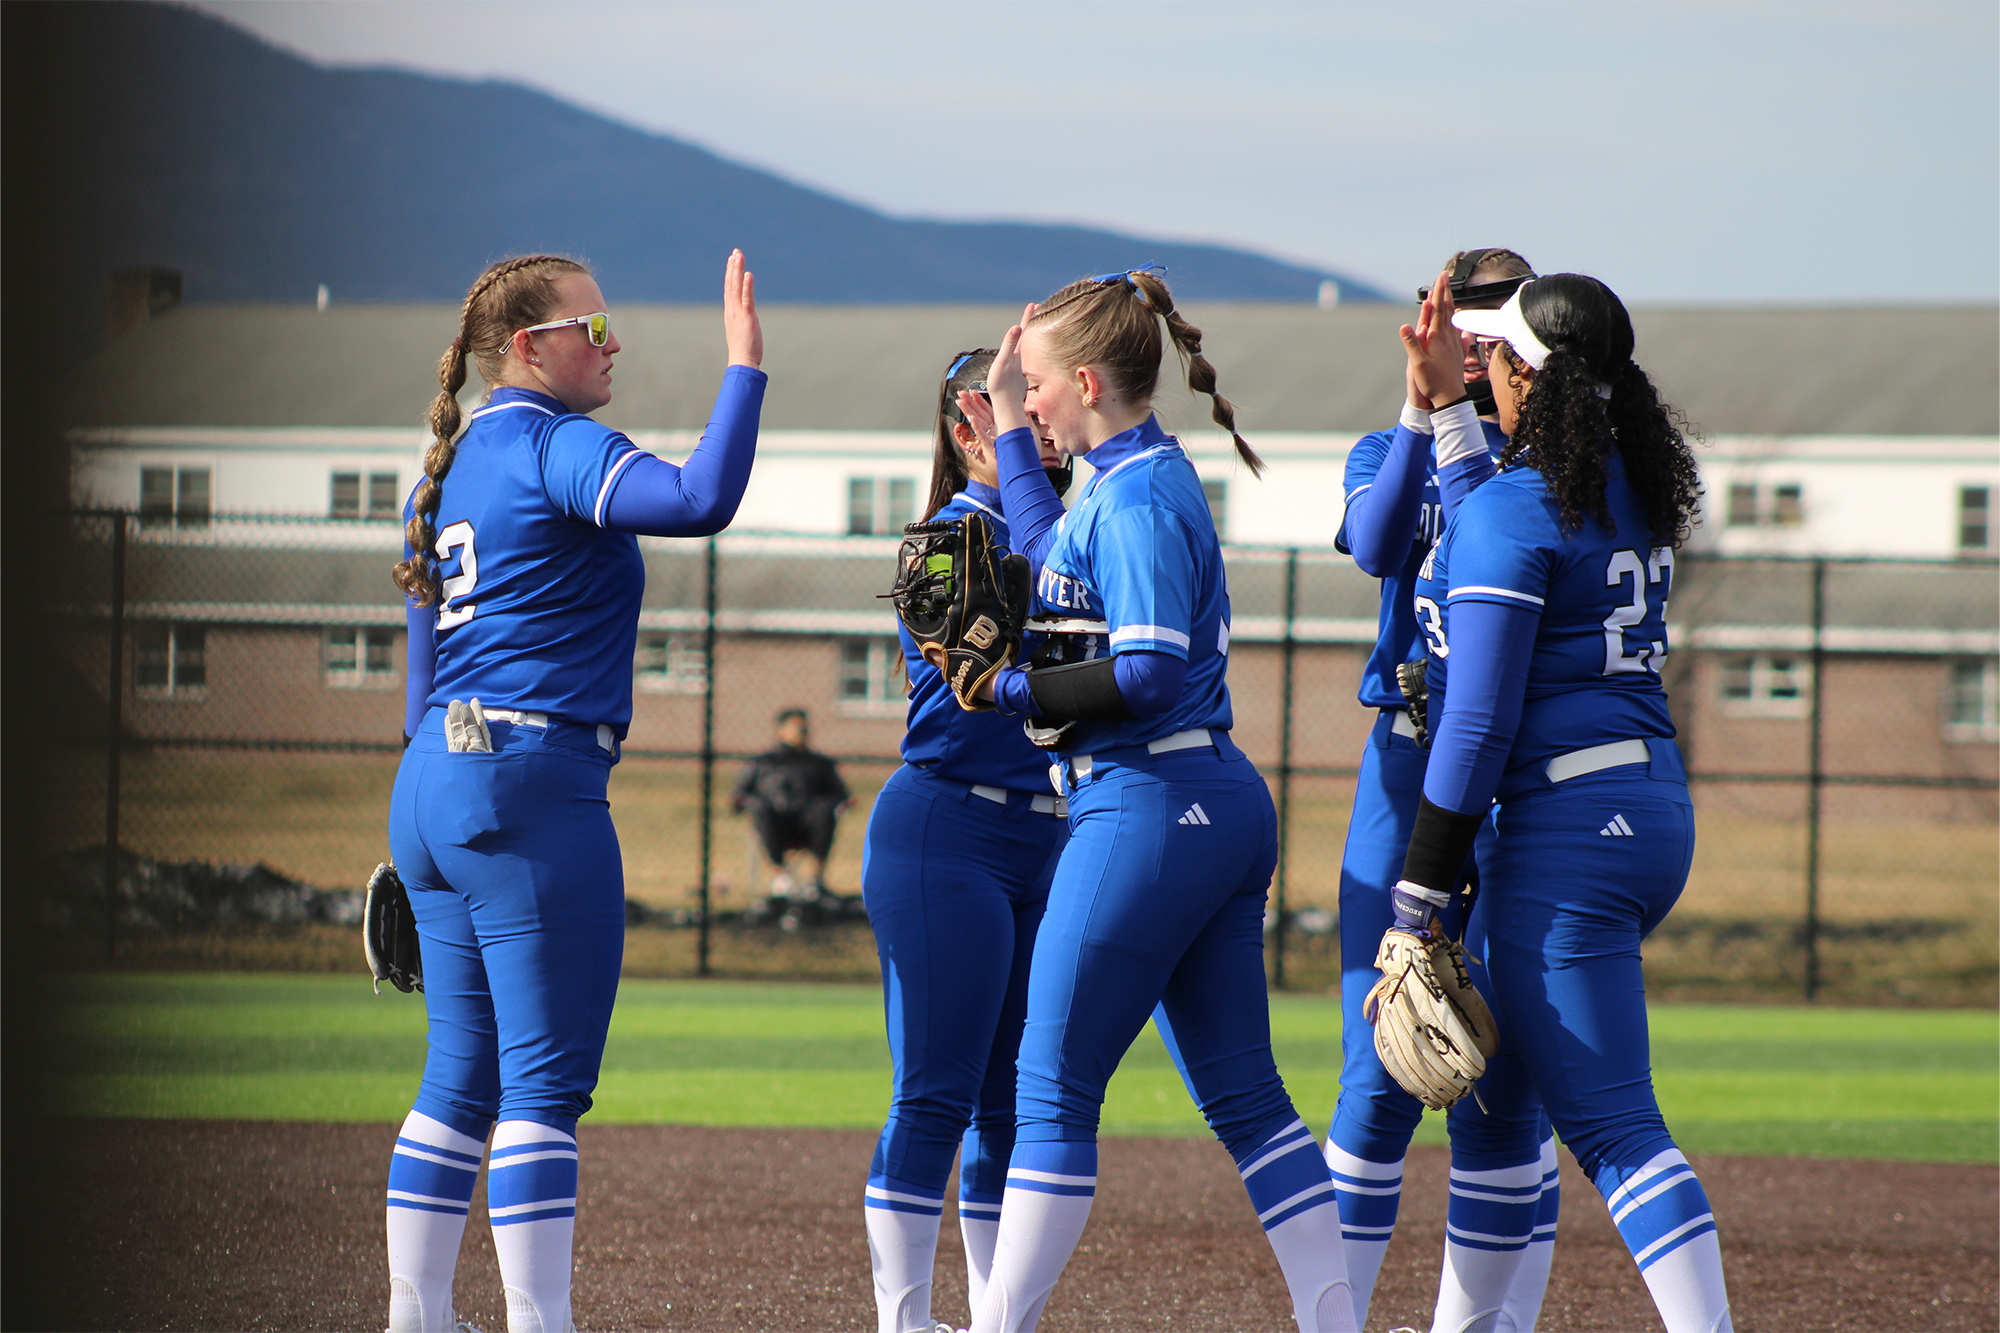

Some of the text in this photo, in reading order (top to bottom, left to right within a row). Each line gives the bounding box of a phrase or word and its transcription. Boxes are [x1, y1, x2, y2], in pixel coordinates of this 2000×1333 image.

[435, 520, 478, 630] 2
[1414, 594, 1450, 659] 3
[1602, 546, 1675, 676] 23
